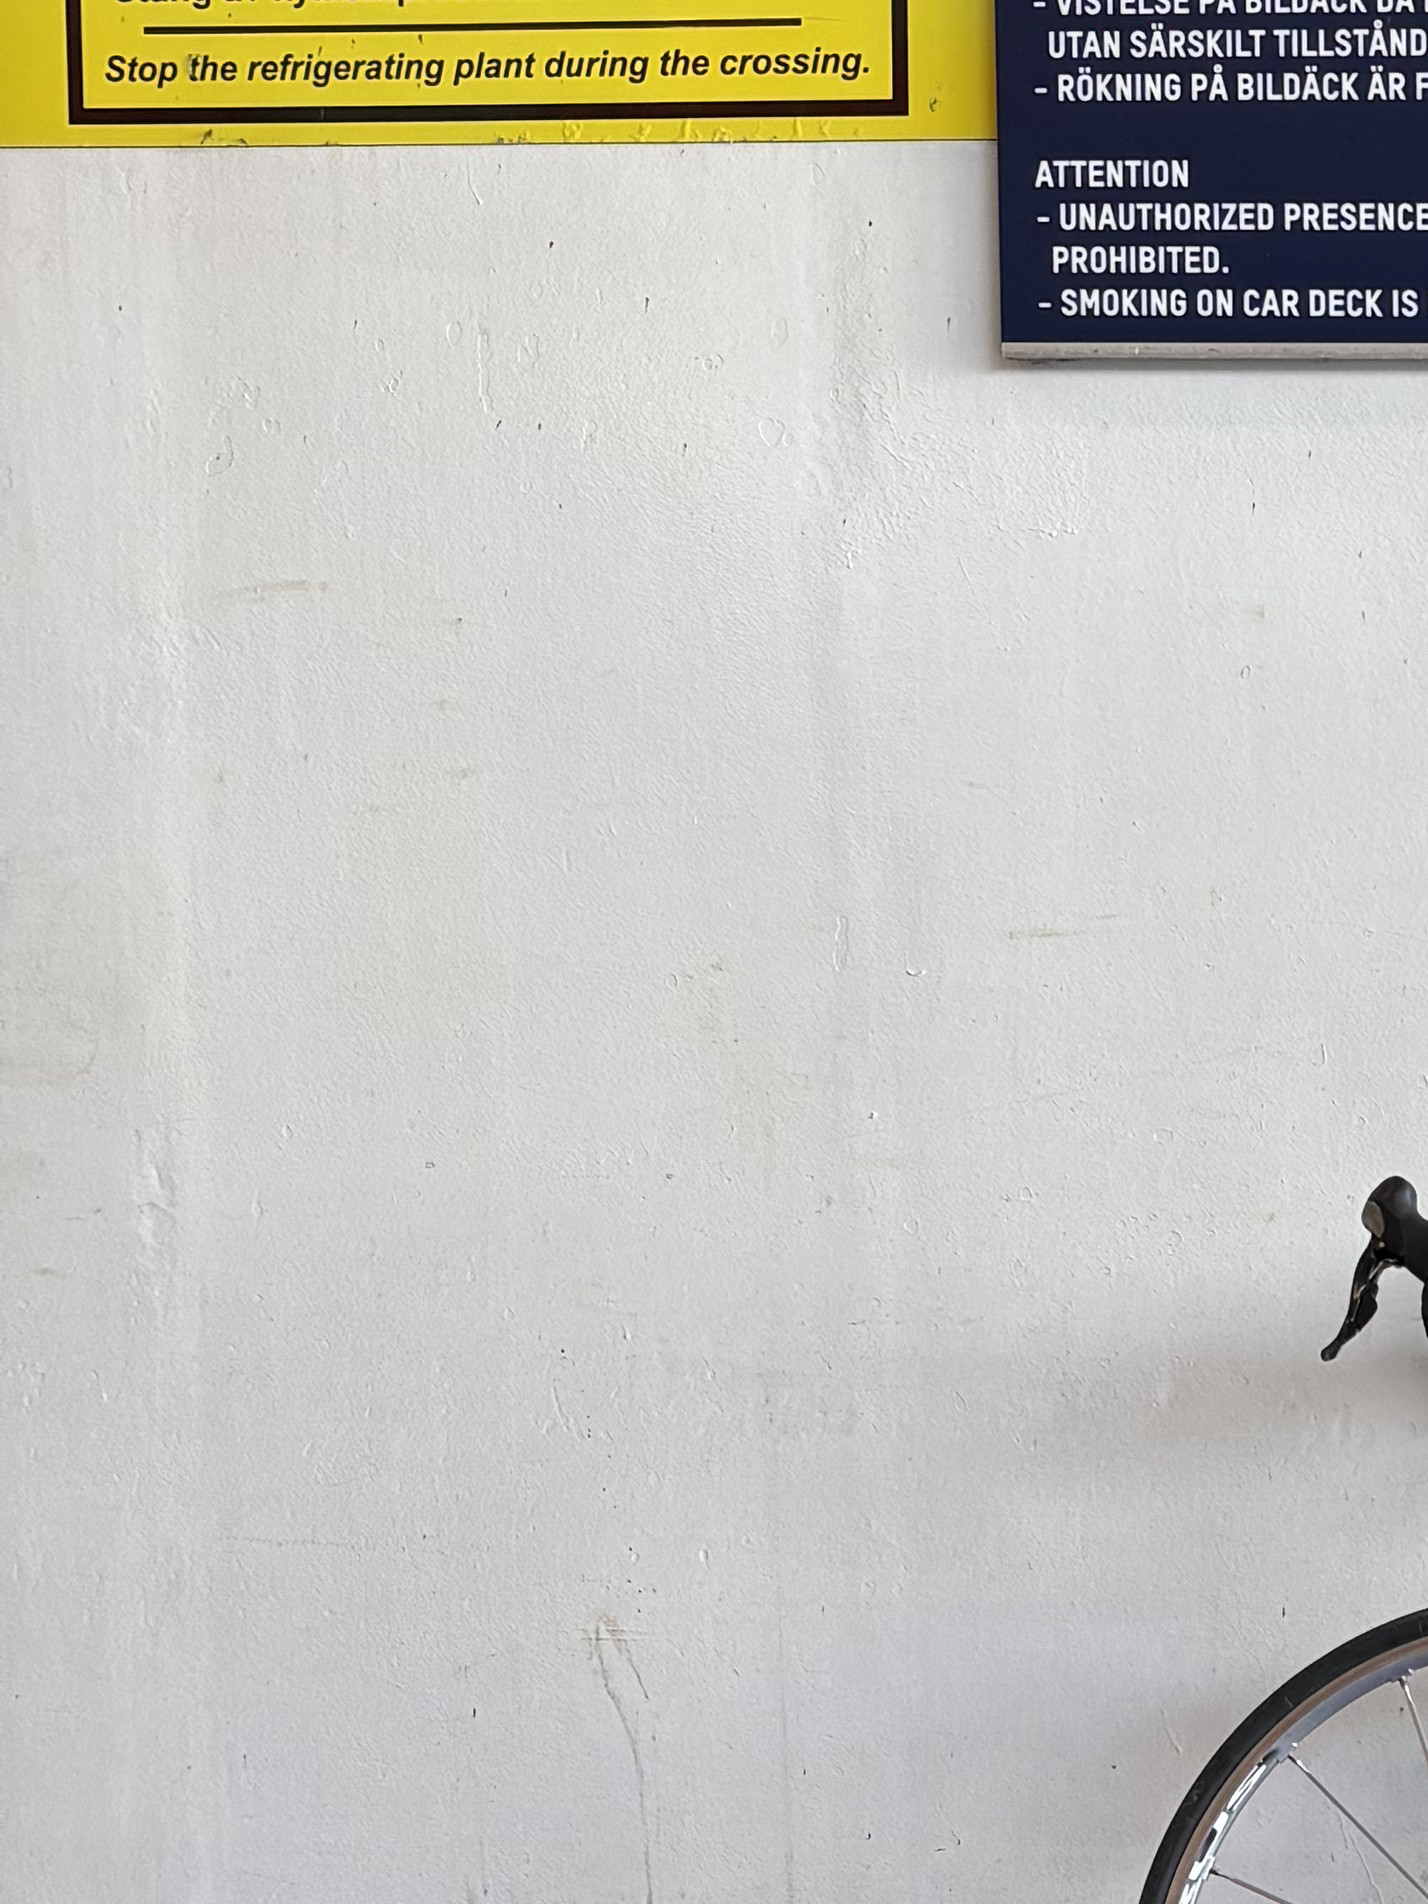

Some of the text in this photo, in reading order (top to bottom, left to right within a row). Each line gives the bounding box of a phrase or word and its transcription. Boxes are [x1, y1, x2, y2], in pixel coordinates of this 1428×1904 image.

[1048, 30, 1121, 59] UTAN
[1129, 22, 1267, 58] SÄRSKILT
[105, 46, 869, 89] Stop the refrigerating plant during the crossing.
[1057, 66, 1182, 102] RÖKNING
[1191, 63, 1229, 101] PÅ
[1237, 65, 1360, 101] BILDÄCK
[1367, 65, 1407, 101] ÄR
[1034, 159, 1189, 188] ATTENTION
[1059, 202, 1274, 231] UNAUTHORIZED
[1052, 245, 1230, 274] PROHIBITED.
[1060, 288, 1187, 317] SMOKING
[1196, 288, 1233, 317] ON
[1243, 288, 1300, 317] CAR
[1308, 289, 1384, 318] DECK
[1392, 289, 1419, 318] IS
